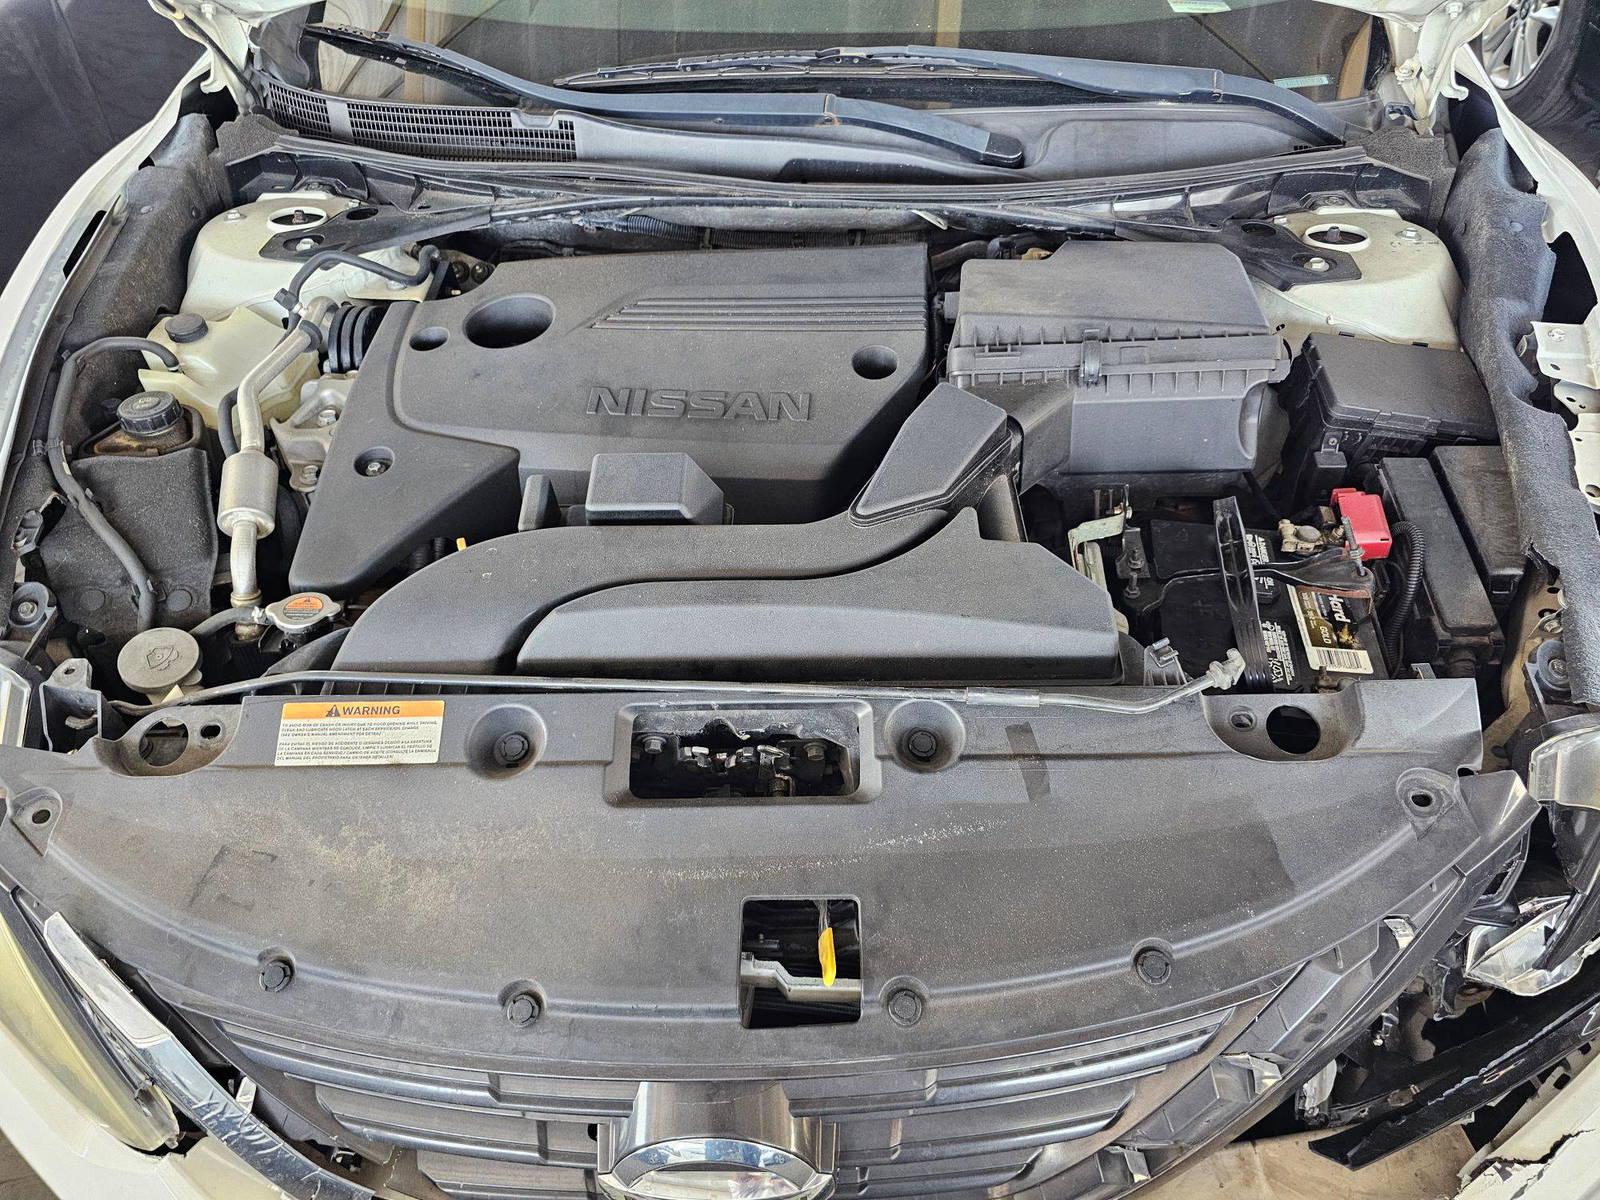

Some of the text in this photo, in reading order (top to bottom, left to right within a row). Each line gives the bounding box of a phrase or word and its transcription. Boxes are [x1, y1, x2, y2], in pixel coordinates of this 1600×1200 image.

[586, 386, 812, 421] NISSAN
[1320, 626, 1332, 644] GOLD
[342, 705, 400, 715] WARNING
